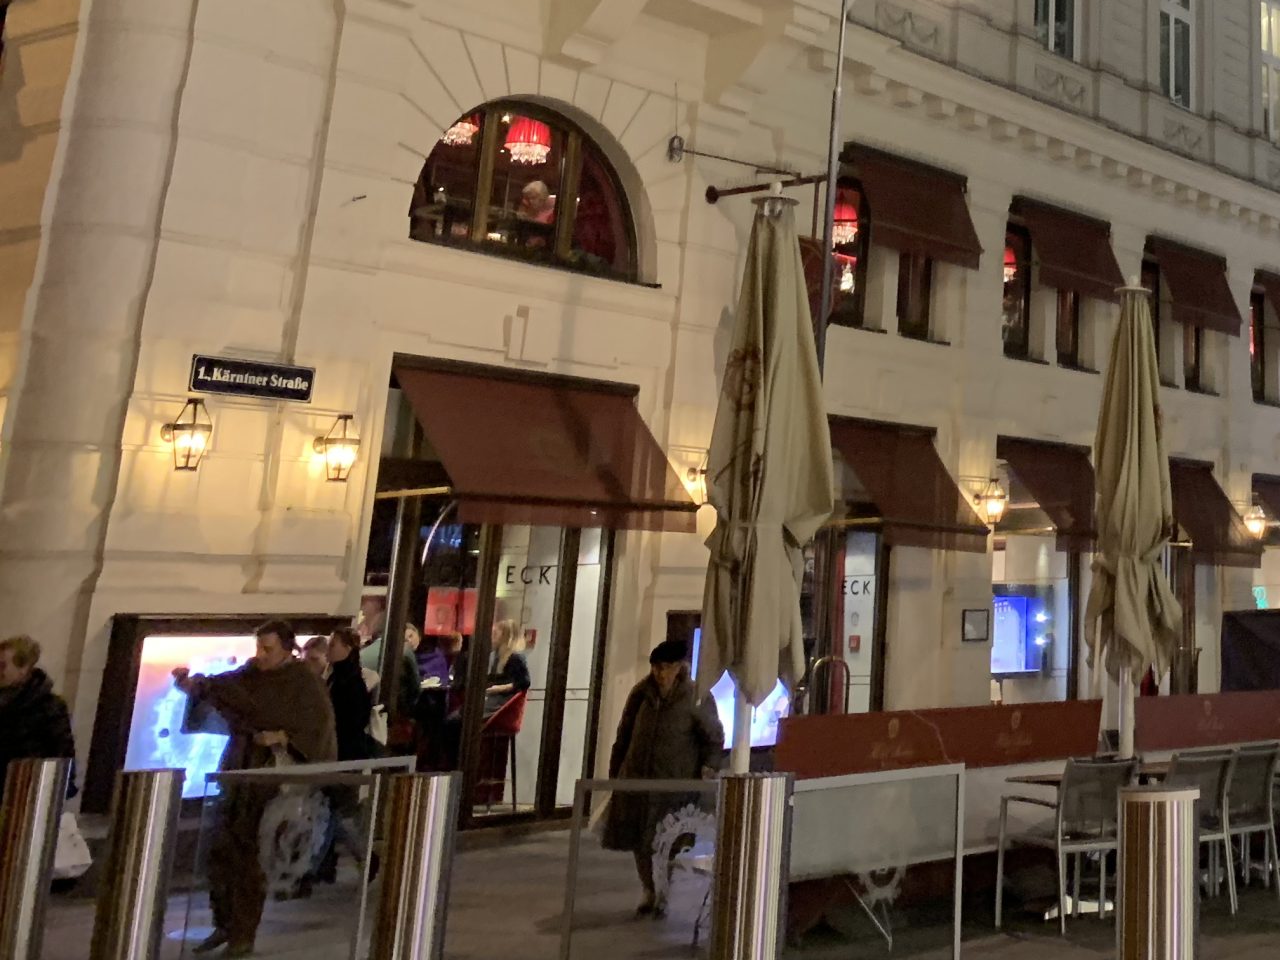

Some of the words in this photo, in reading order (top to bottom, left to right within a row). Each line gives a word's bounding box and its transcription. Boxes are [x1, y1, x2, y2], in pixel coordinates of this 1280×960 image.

[212, 367, 268, 387] Kärntner
[270, 374, 309, 391] Straße
[506, 565, 551, 585] ECK
